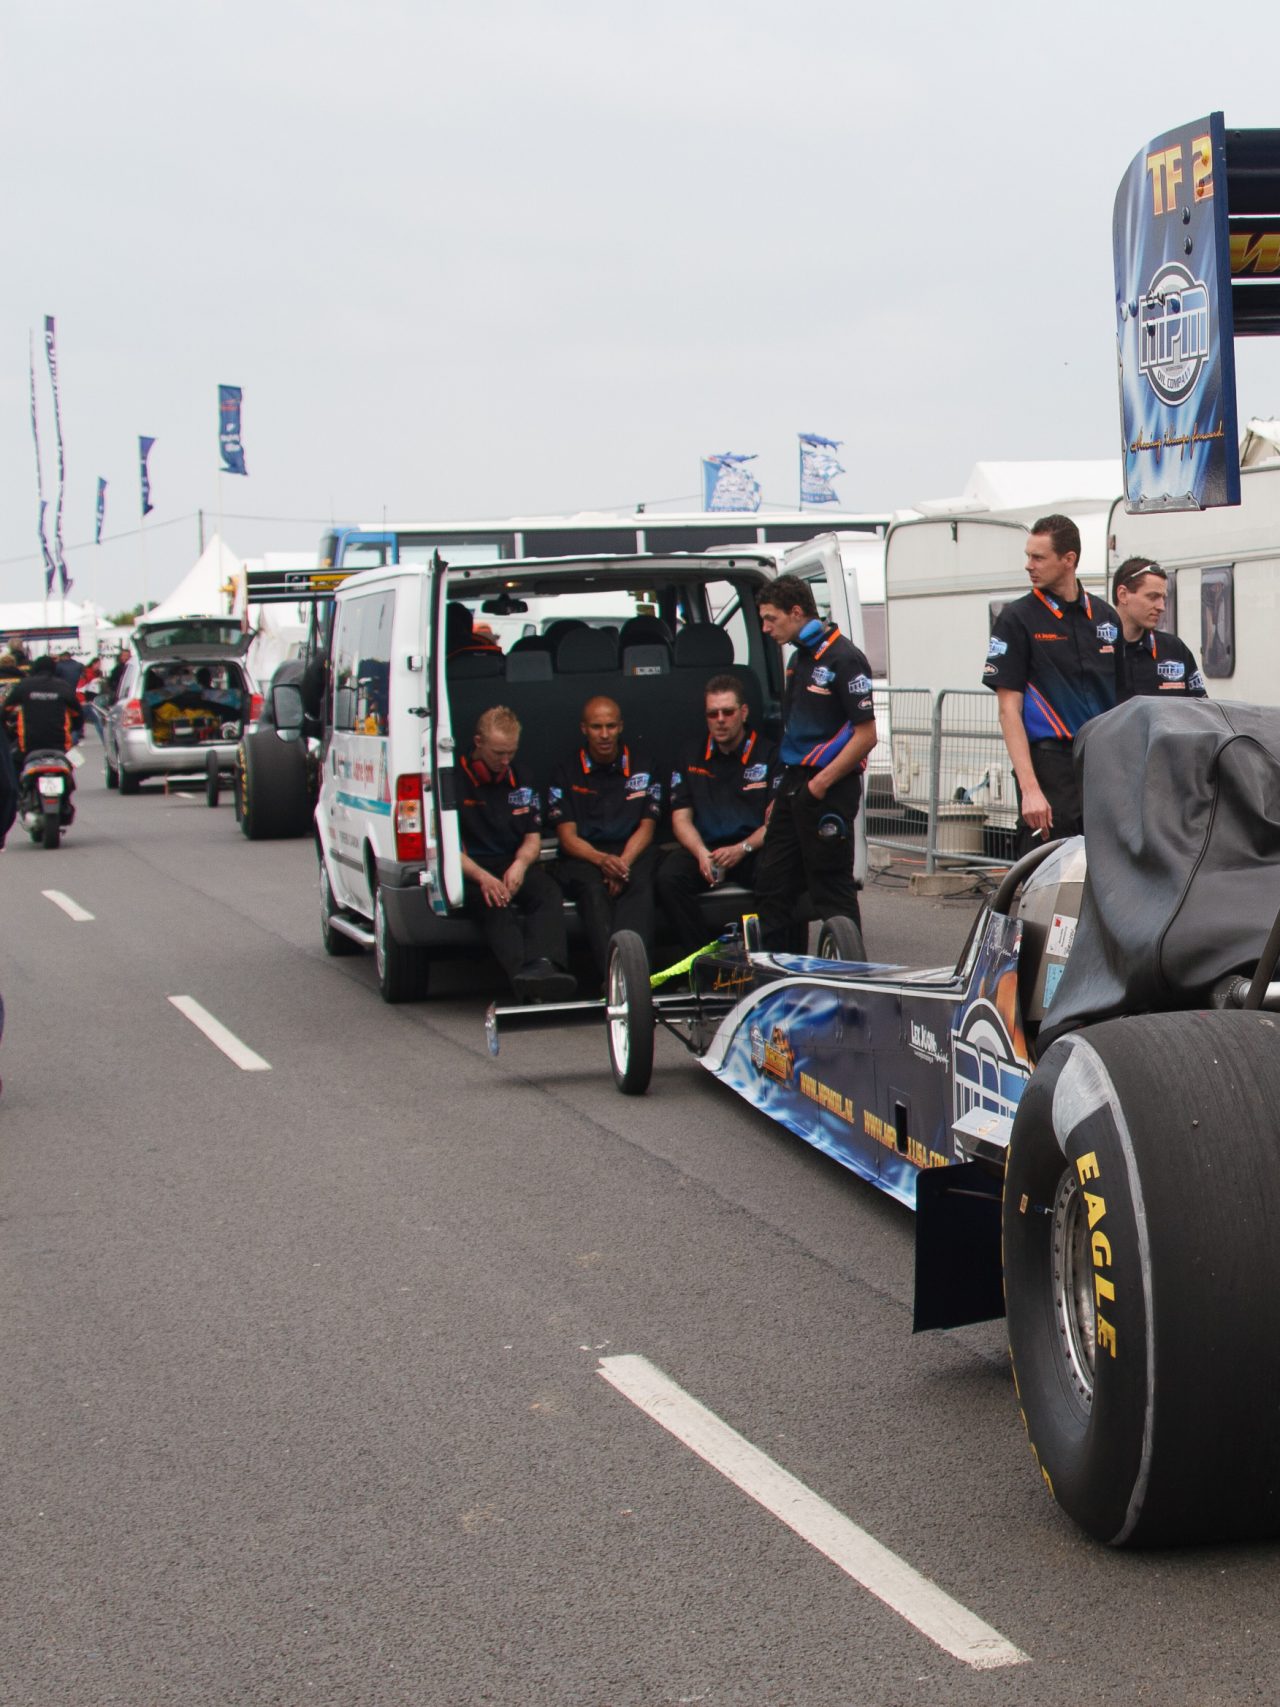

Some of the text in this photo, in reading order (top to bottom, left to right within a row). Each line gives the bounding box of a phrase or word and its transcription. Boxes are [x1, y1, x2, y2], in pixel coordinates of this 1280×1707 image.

[1146, 133, 1214, 216] TF 2
[1075, 1151, 1117, 1359] EAGLE
